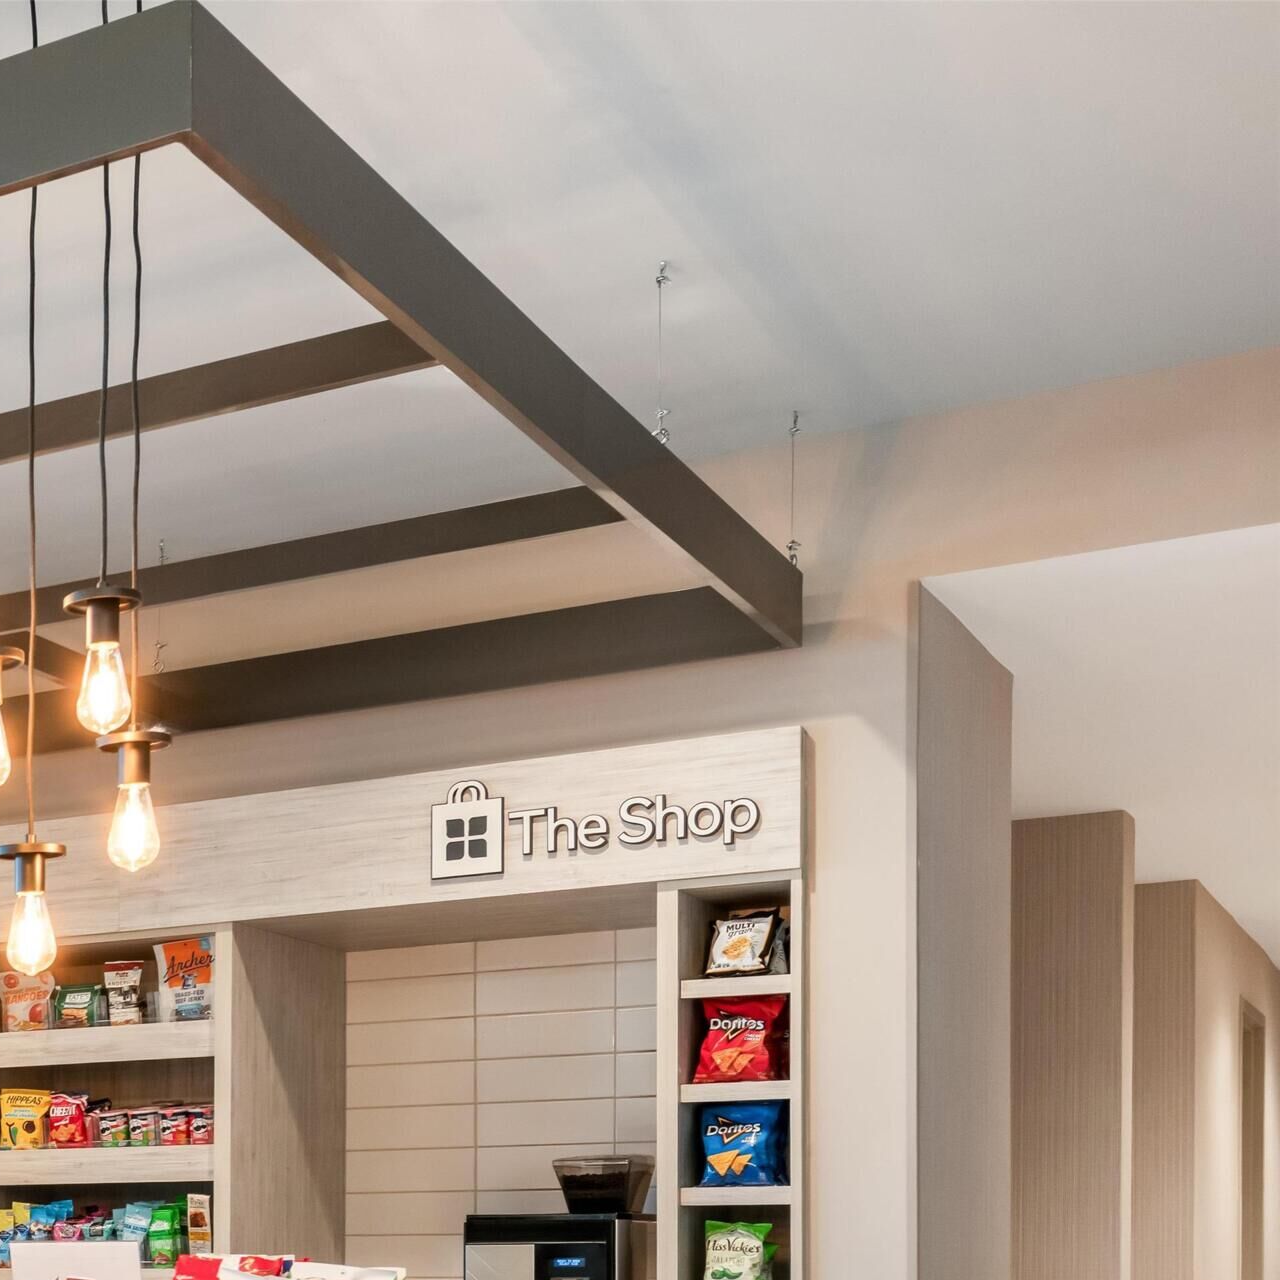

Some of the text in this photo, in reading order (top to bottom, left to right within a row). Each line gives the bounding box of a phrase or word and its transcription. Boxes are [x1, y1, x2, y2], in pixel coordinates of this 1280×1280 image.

[508, 794, 760, 856] The Shop
[726, 922, 756, 933] MULTI
[727, 928, 753, 939] grain
[709, 1018, 765, 1031] Doritos
[6, 1095, 44, 1105] HIPPEAS
[706, 1123, 761, 1136] Doritos
[727, 1238, 761, 1256] Vickie's
